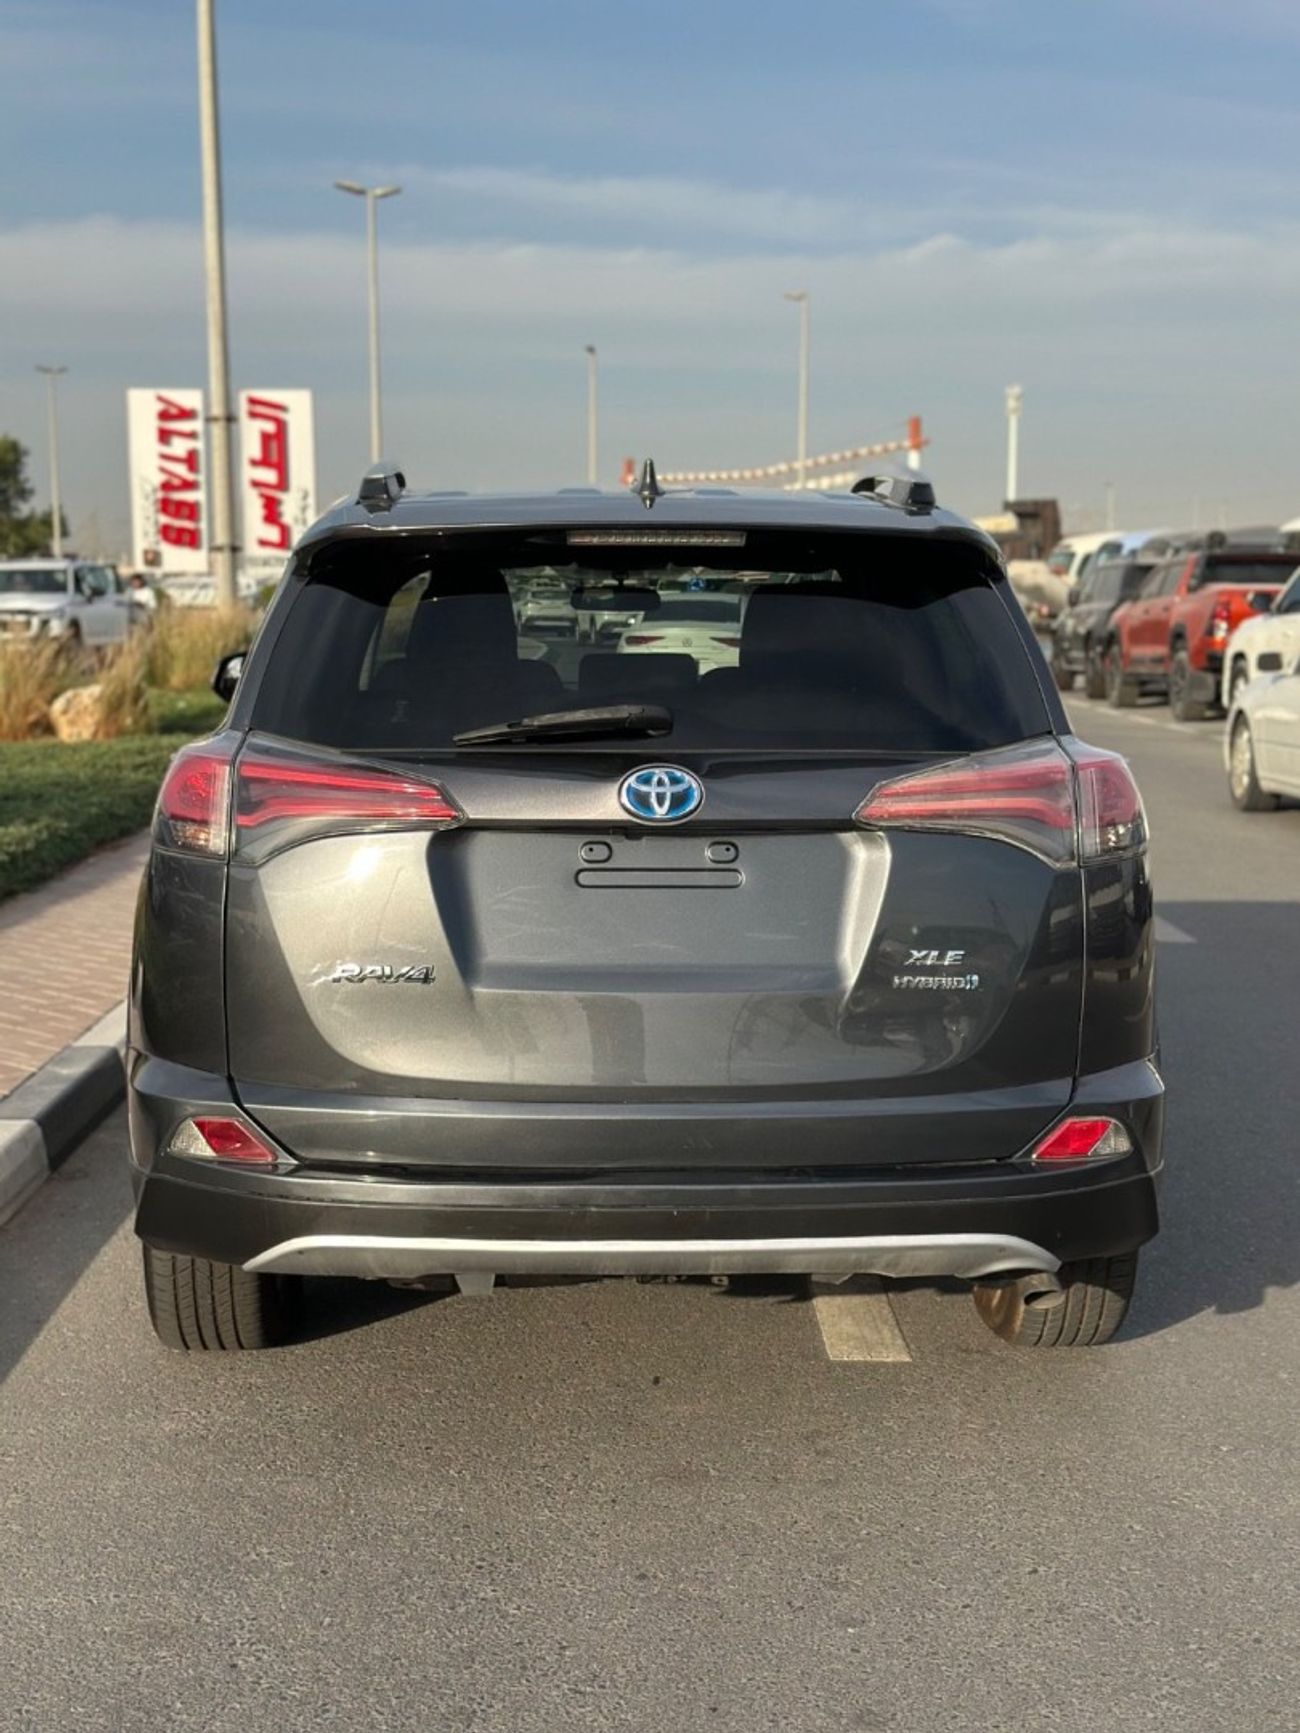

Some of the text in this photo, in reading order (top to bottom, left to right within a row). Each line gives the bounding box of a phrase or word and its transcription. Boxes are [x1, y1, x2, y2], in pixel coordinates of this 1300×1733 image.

[904, 949, 965, 966] XLE
[332, 962, 436, 984] RAV4
[892, 975, 966, 990] HYBRID
